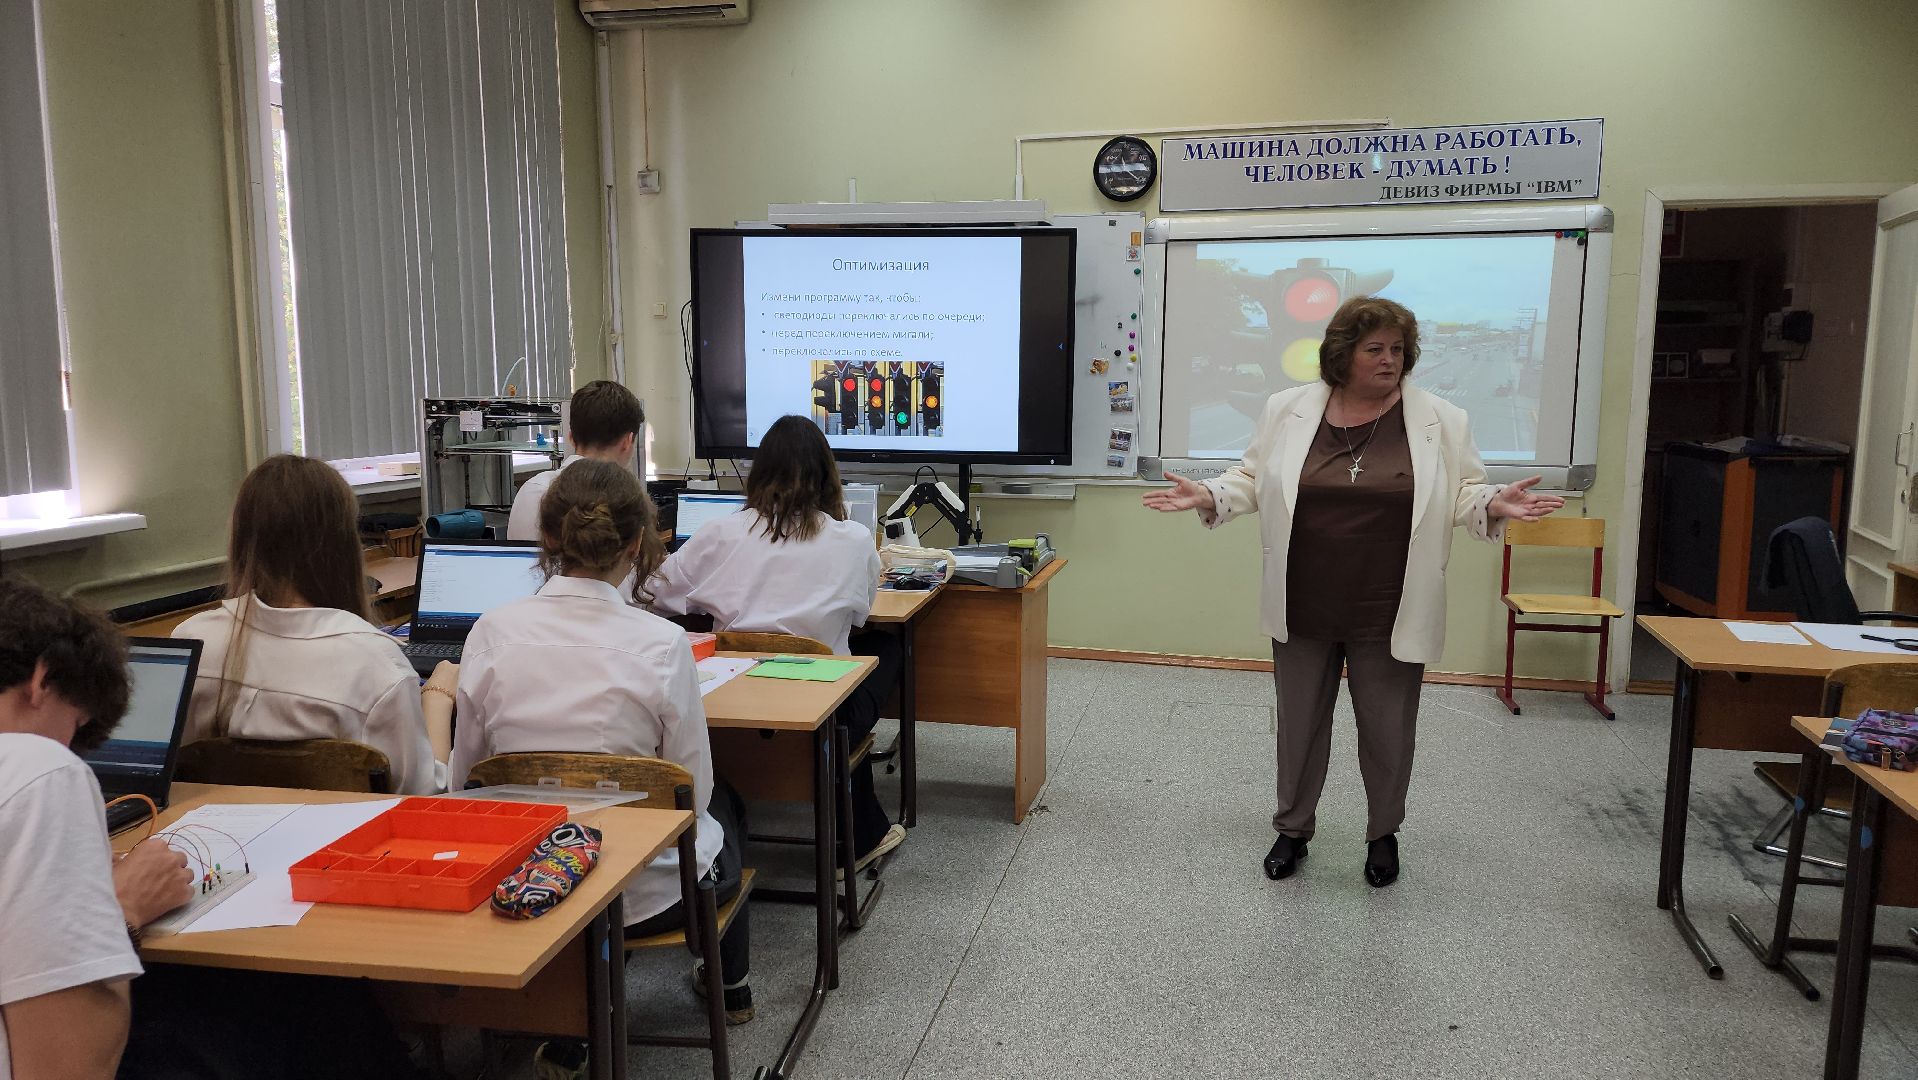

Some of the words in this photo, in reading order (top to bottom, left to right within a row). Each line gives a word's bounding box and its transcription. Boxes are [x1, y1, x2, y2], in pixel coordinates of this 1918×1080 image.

[1182, 140, 1301, 161] МАШИНА
[1306, 134, 1427, 159] ДОЛЖНА
[1434, 126, 1582, 151] РАБОТАТЬ,
[1244, 162, 1366, 184] ЧЕЛОВЕК
[1385, 155, 1498, 181] ДУМАТЬ
[1379, 185, 1440, 200] ДЕВИЗ
[1444, 181, 1522, 197] ФИРМЫ
[831, 258, 929, 272] Оптимизация
[761, 292, 801, 302] Измени
[804, 294, 861, 304] программу
[922, 313, 935, 321] по
